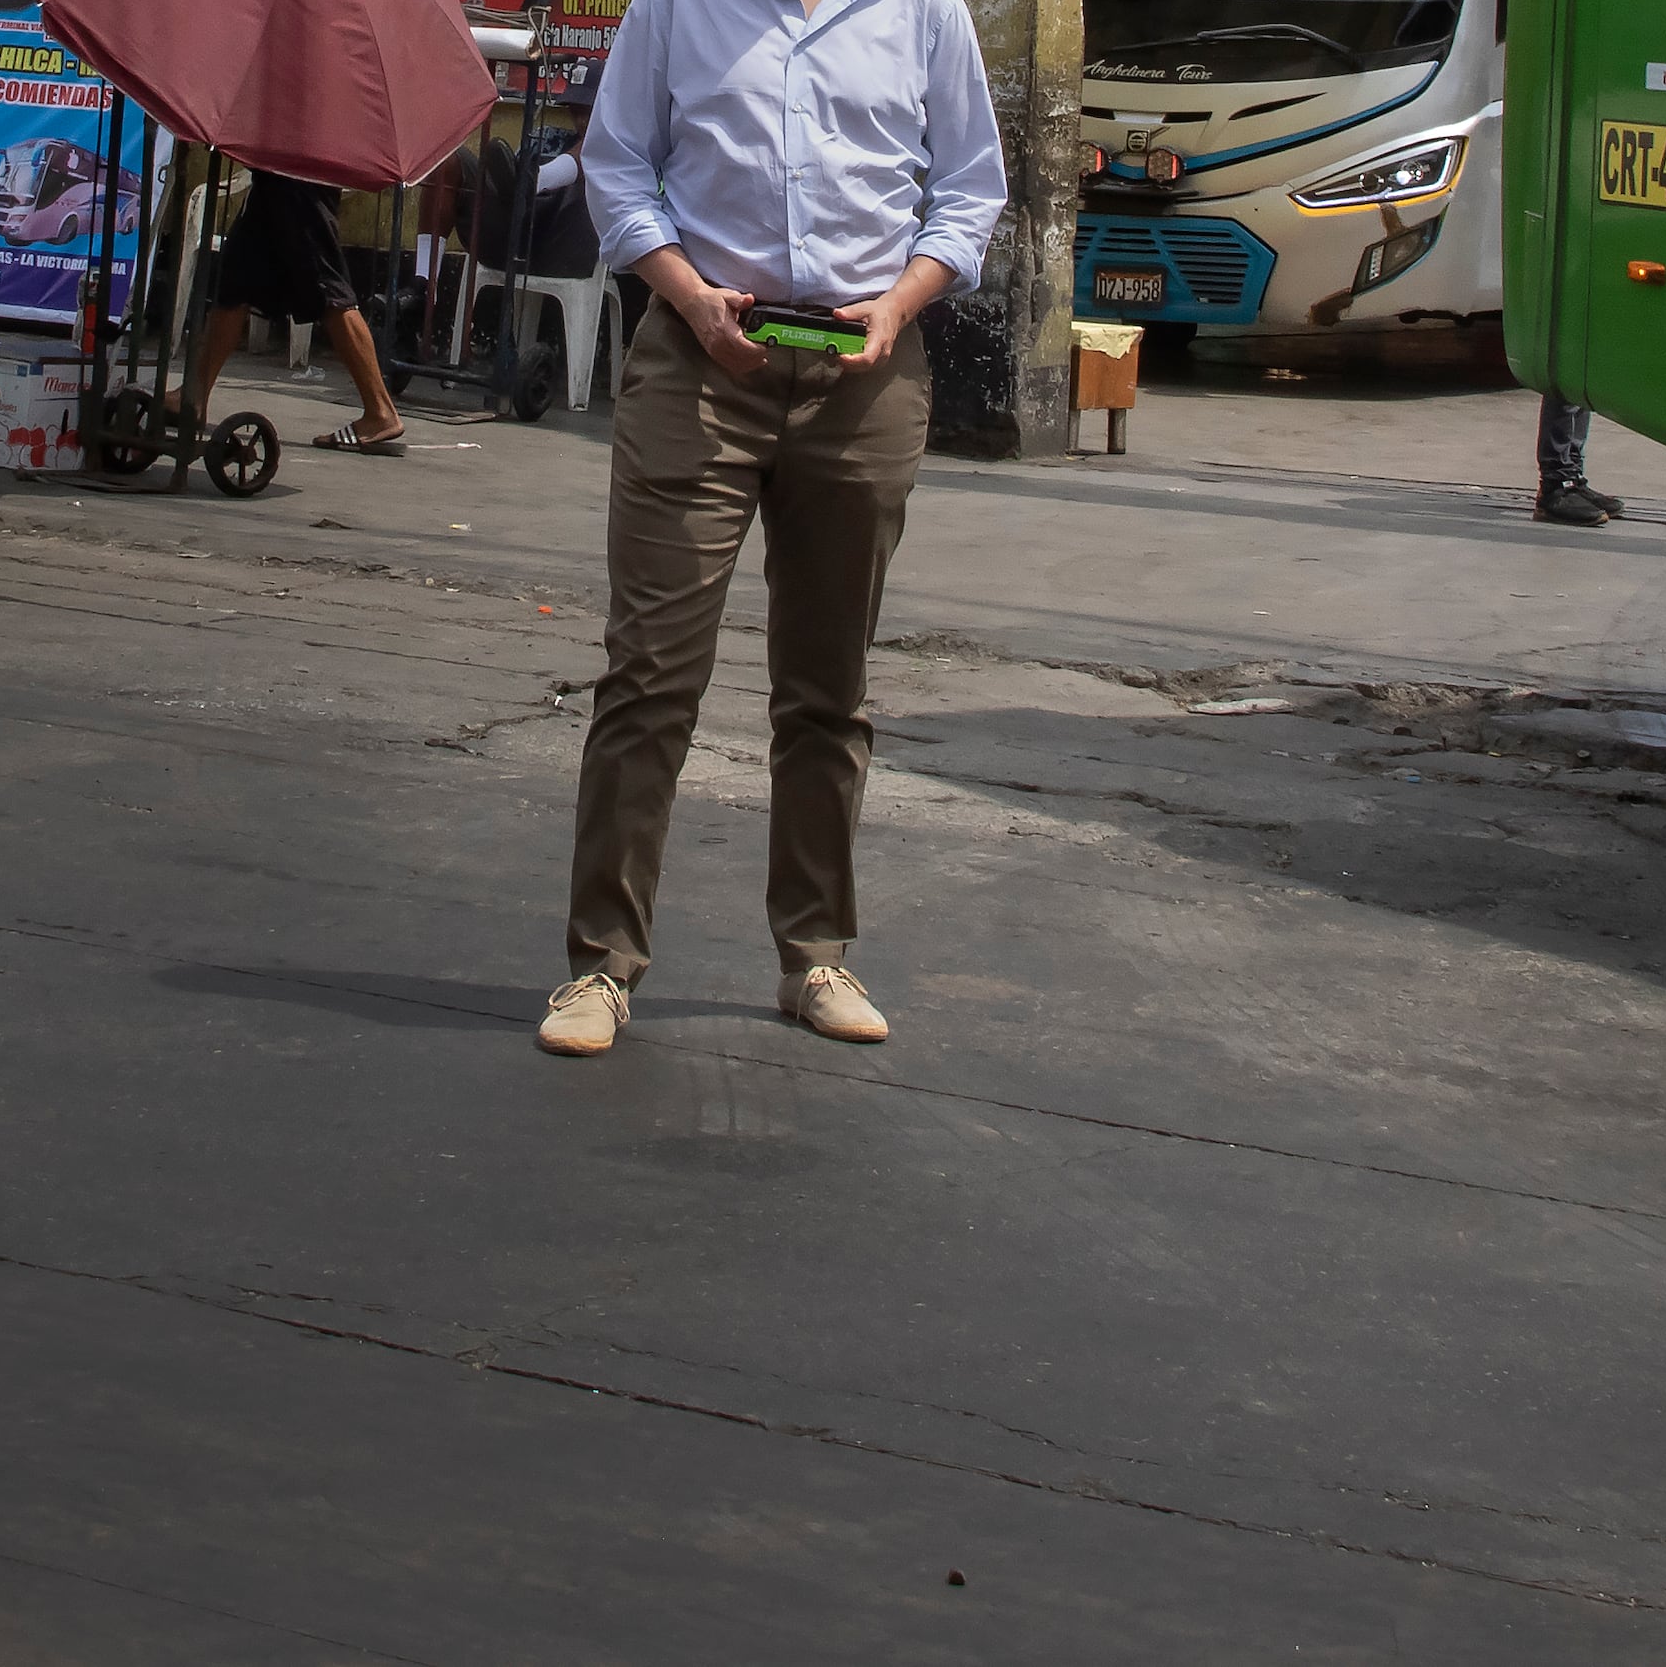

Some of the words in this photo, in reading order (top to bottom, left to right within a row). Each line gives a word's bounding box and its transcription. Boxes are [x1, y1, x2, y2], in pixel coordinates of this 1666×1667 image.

[561, 24, 602, 51] Naranjo
[1176, 63, 1214, 82] Tours
[36, 255, 89, 272] VICTORIA
